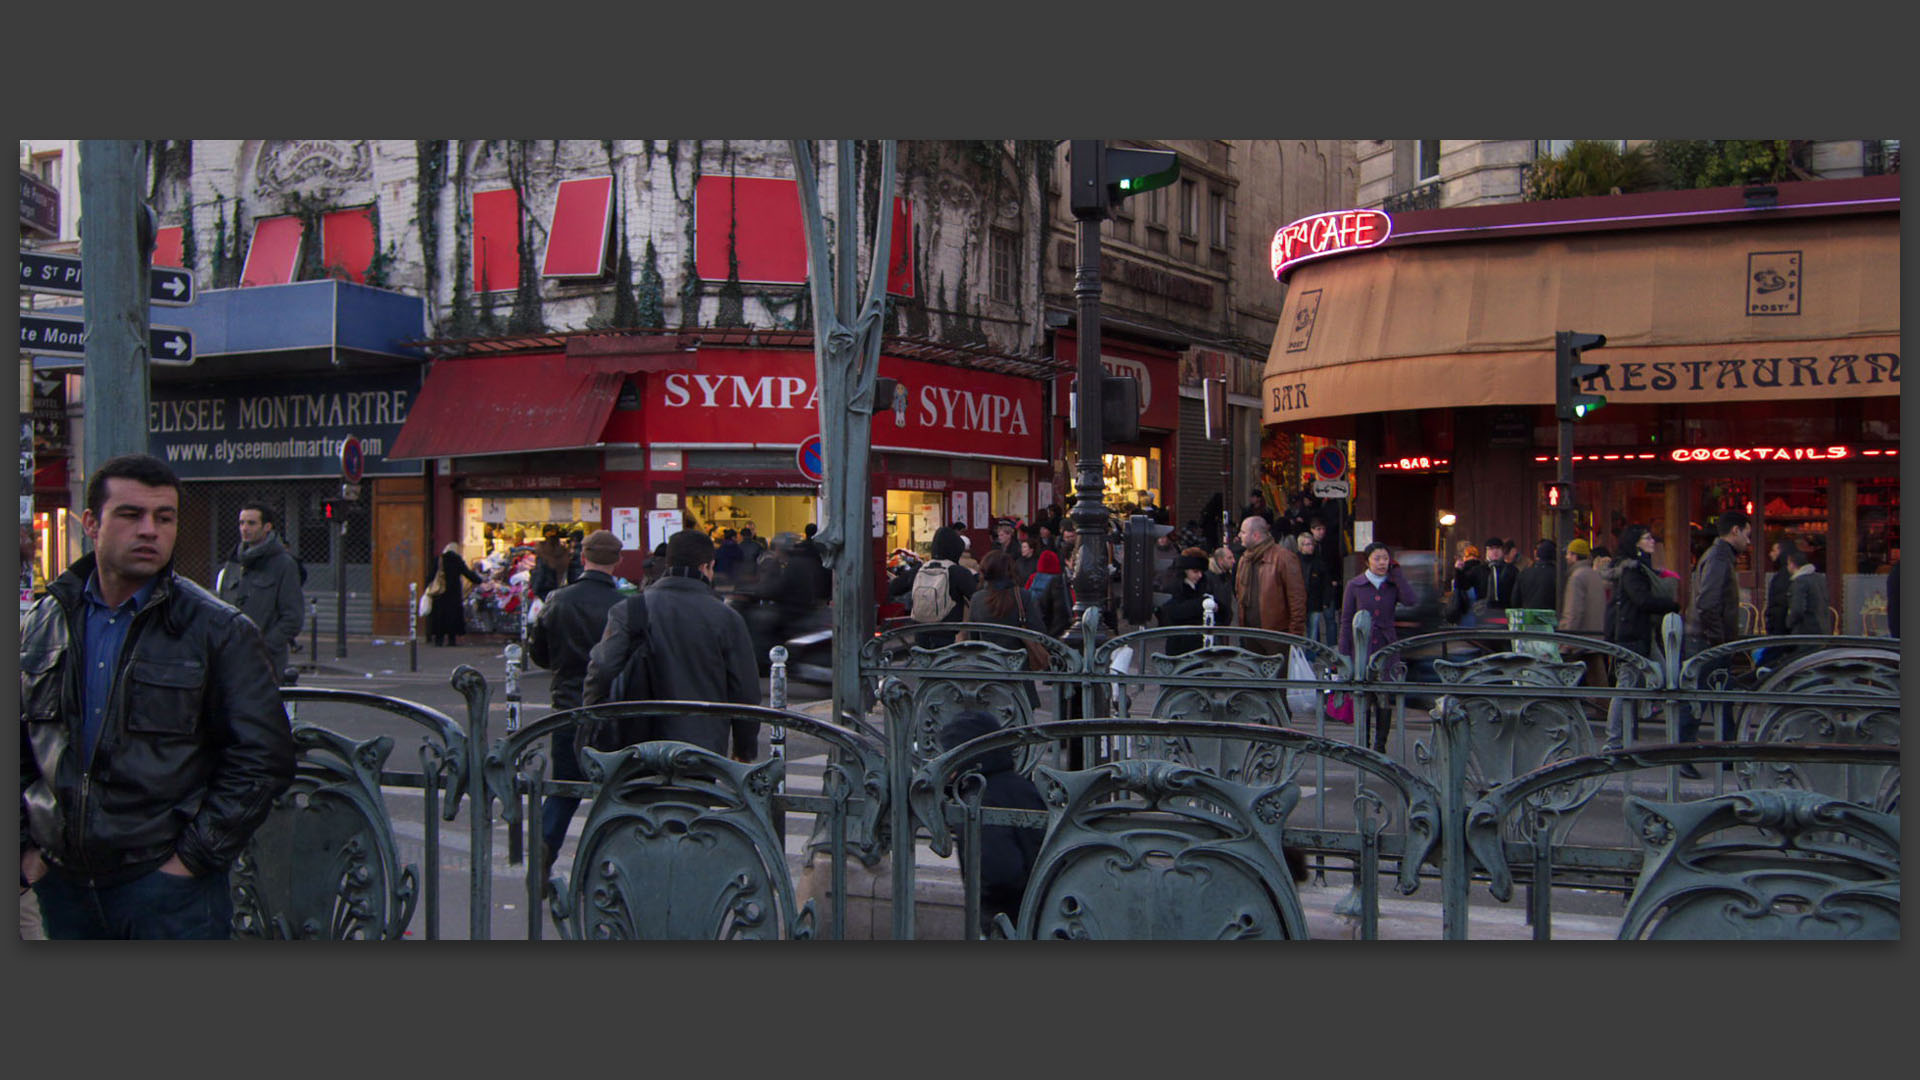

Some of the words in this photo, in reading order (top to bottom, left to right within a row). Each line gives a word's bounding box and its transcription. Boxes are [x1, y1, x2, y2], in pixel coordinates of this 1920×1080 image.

[1310, 212, 1376, 253] CAFE
[21, 327, 37, 342] te
[238, 390, 408, 430] MONTMARTRE
[919, 384, 1030, 436] SYMPA
[1272, 383, 1310, 413] BAR
[149, 398, 226, 433] ELYSEE
[166, 436, 382, 465] www.elyseemontmartreom
[1400, 457, 1431, 470] BAR
[1671, 446, 1848, 462] COCKTAILS
